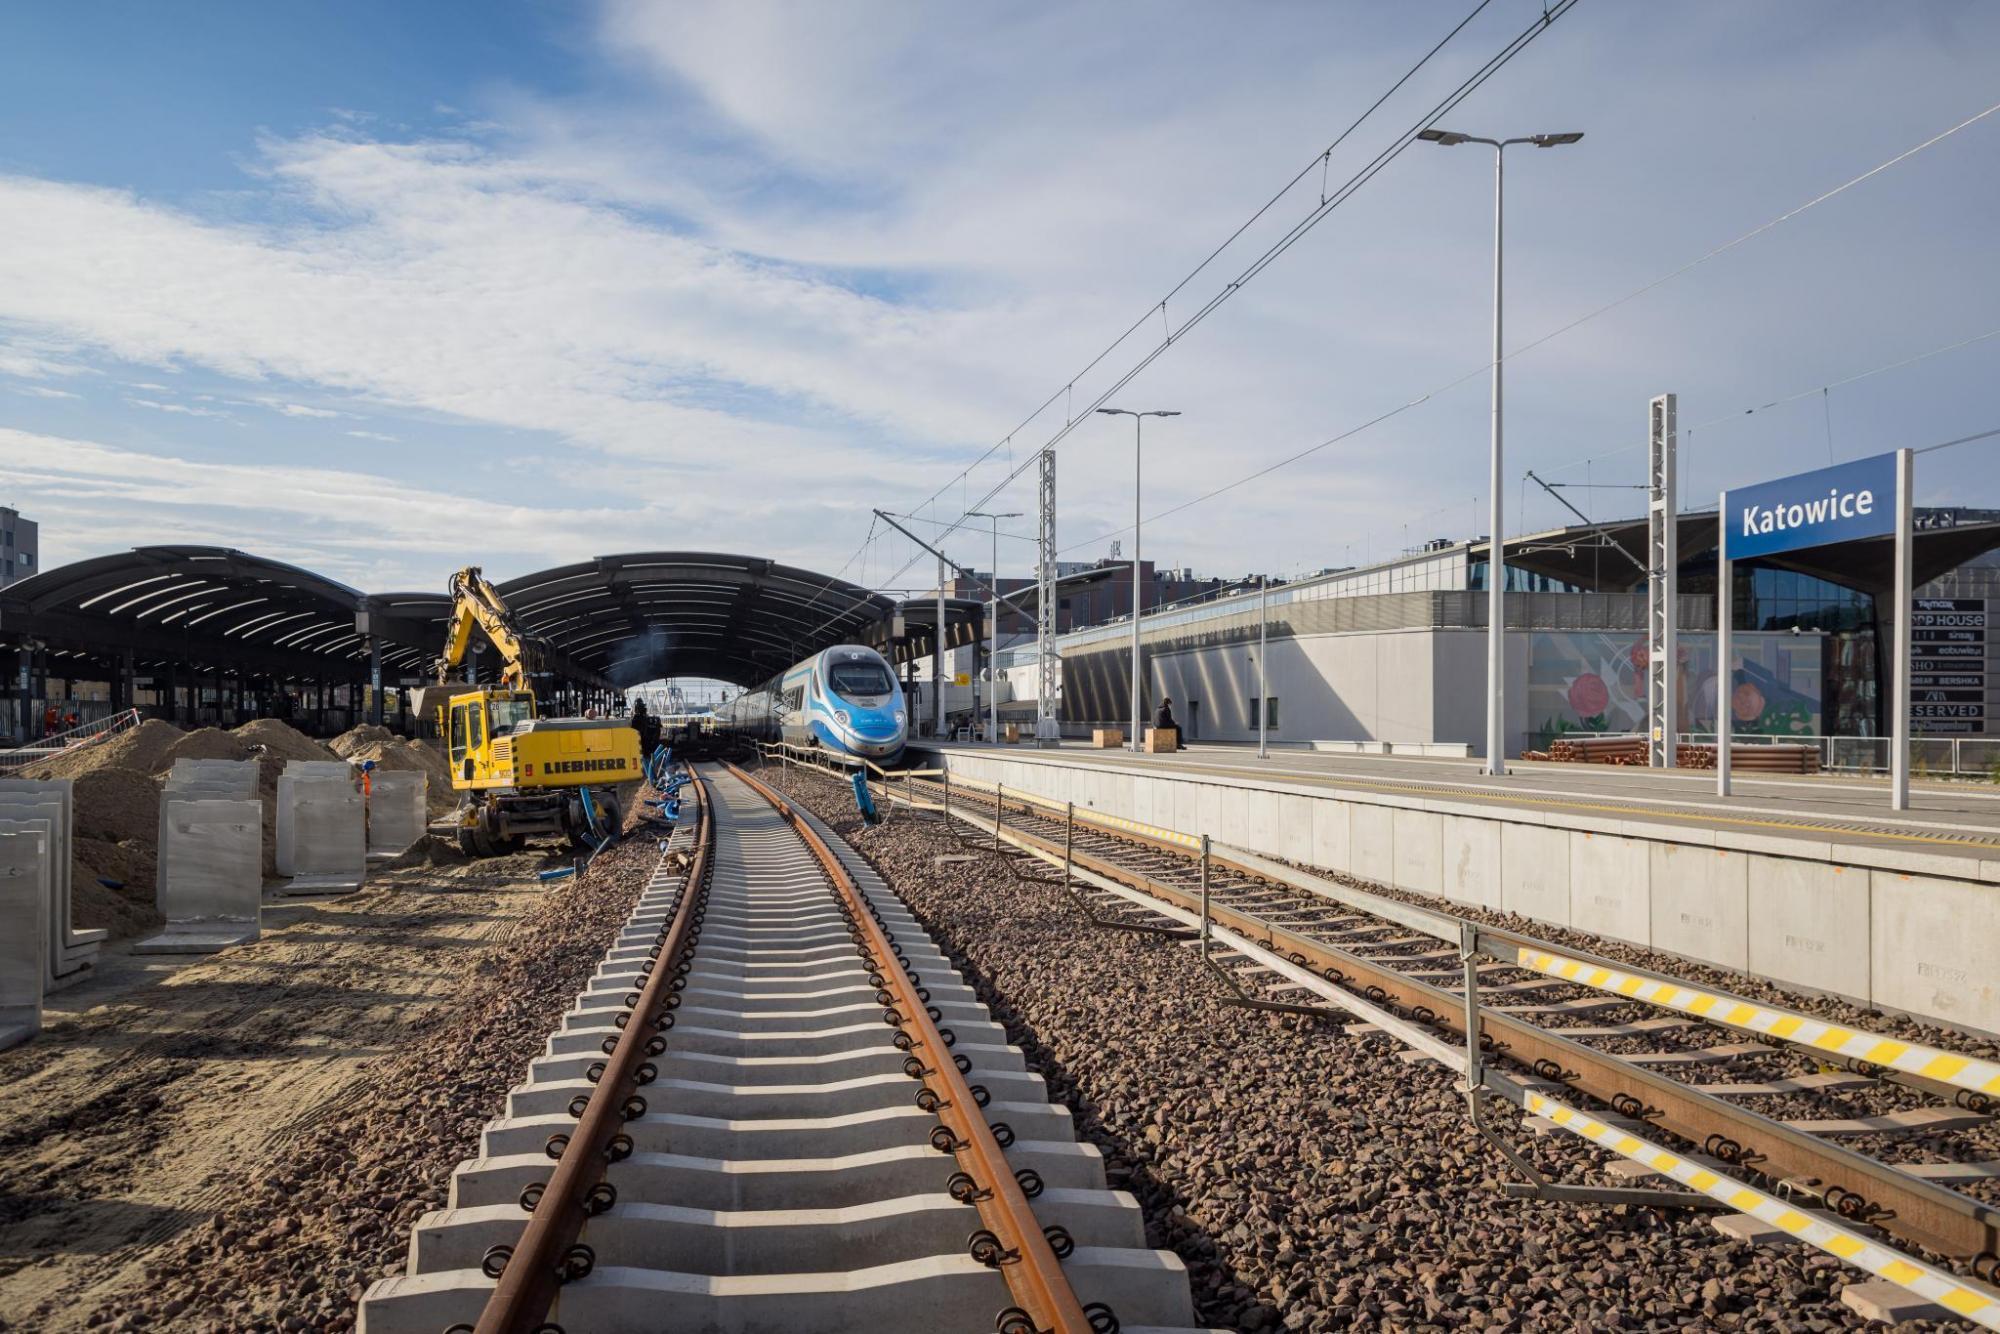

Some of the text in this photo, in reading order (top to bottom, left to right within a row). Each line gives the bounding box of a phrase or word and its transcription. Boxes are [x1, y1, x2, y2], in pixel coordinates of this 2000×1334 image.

[1743, 488, 1873, 537] Katowice
[1939, 677, 1980, 685] BERSHKA
[544, 758, 626, 775] LIEBHERR
